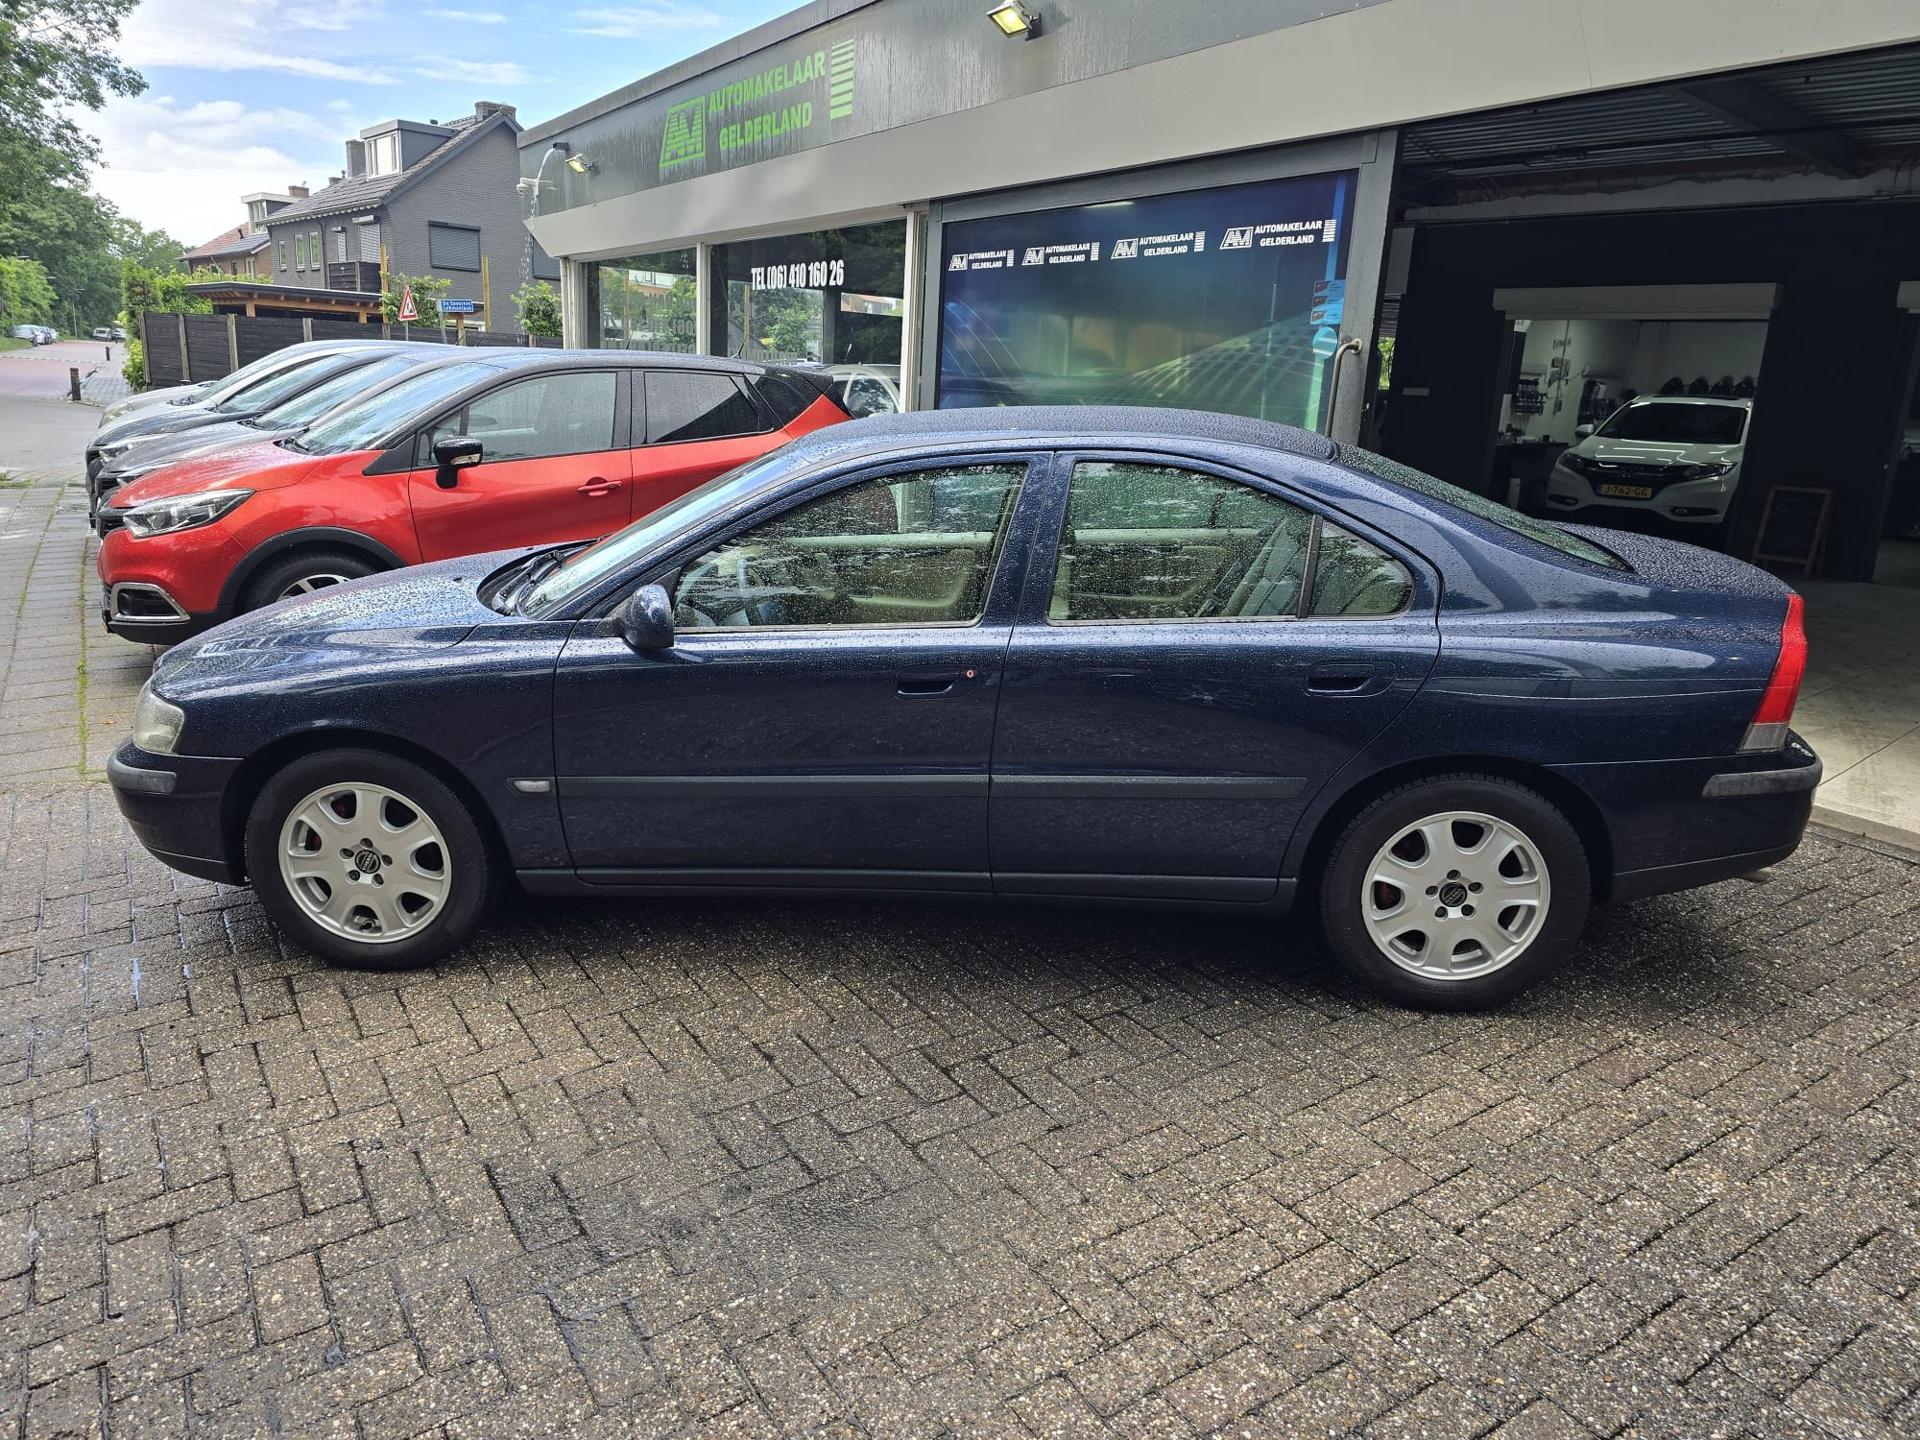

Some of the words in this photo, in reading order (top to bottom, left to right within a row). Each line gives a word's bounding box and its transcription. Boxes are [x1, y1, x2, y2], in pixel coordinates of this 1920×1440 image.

[708, 51, 826, 113] AUTOMAKELAAR
[719, 102, 813, 149] GELDERLAND
[1254, 220, 1323, 235] AUTOMAKELAAR
[1139, 231, 1194, 245] AUTOMAKELAAR
[1259, 234, 1315, 247] GELDERLAND
[1045, 243, 1090, 254] AUTOMAKELAAR
[1143, 245, 1188, 257] GELDERLAND
[968, 250, 1007, 260] AUTOMAKELAAR
[1049, 254, 1086, 264] GELDERLAND
[971, 260, 1003, 270] GELDERLAND
[751, 266, 766, 291] TEL
[766, 264, 788, 290] (06)
[788, 263, 807, 288] 410
[808, 260, 828, 287] 160
[829, 259, 845, 286] 26
[1604, 485, 1649, 497] J-762-GG
